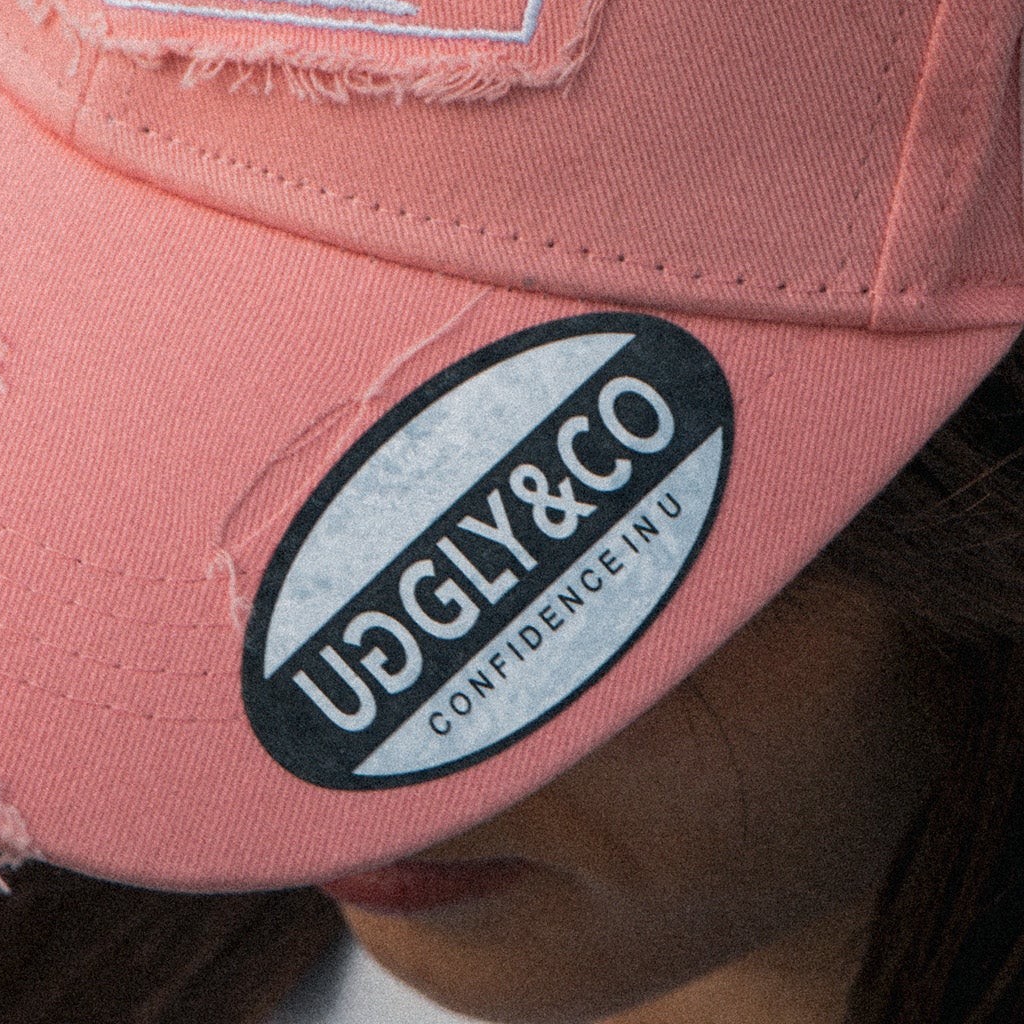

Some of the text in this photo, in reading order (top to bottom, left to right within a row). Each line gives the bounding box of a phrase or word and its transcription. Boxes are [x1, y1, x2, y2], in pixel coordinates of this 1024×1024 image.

[428, 492, 682, 736] CONFIDENCE IN U
